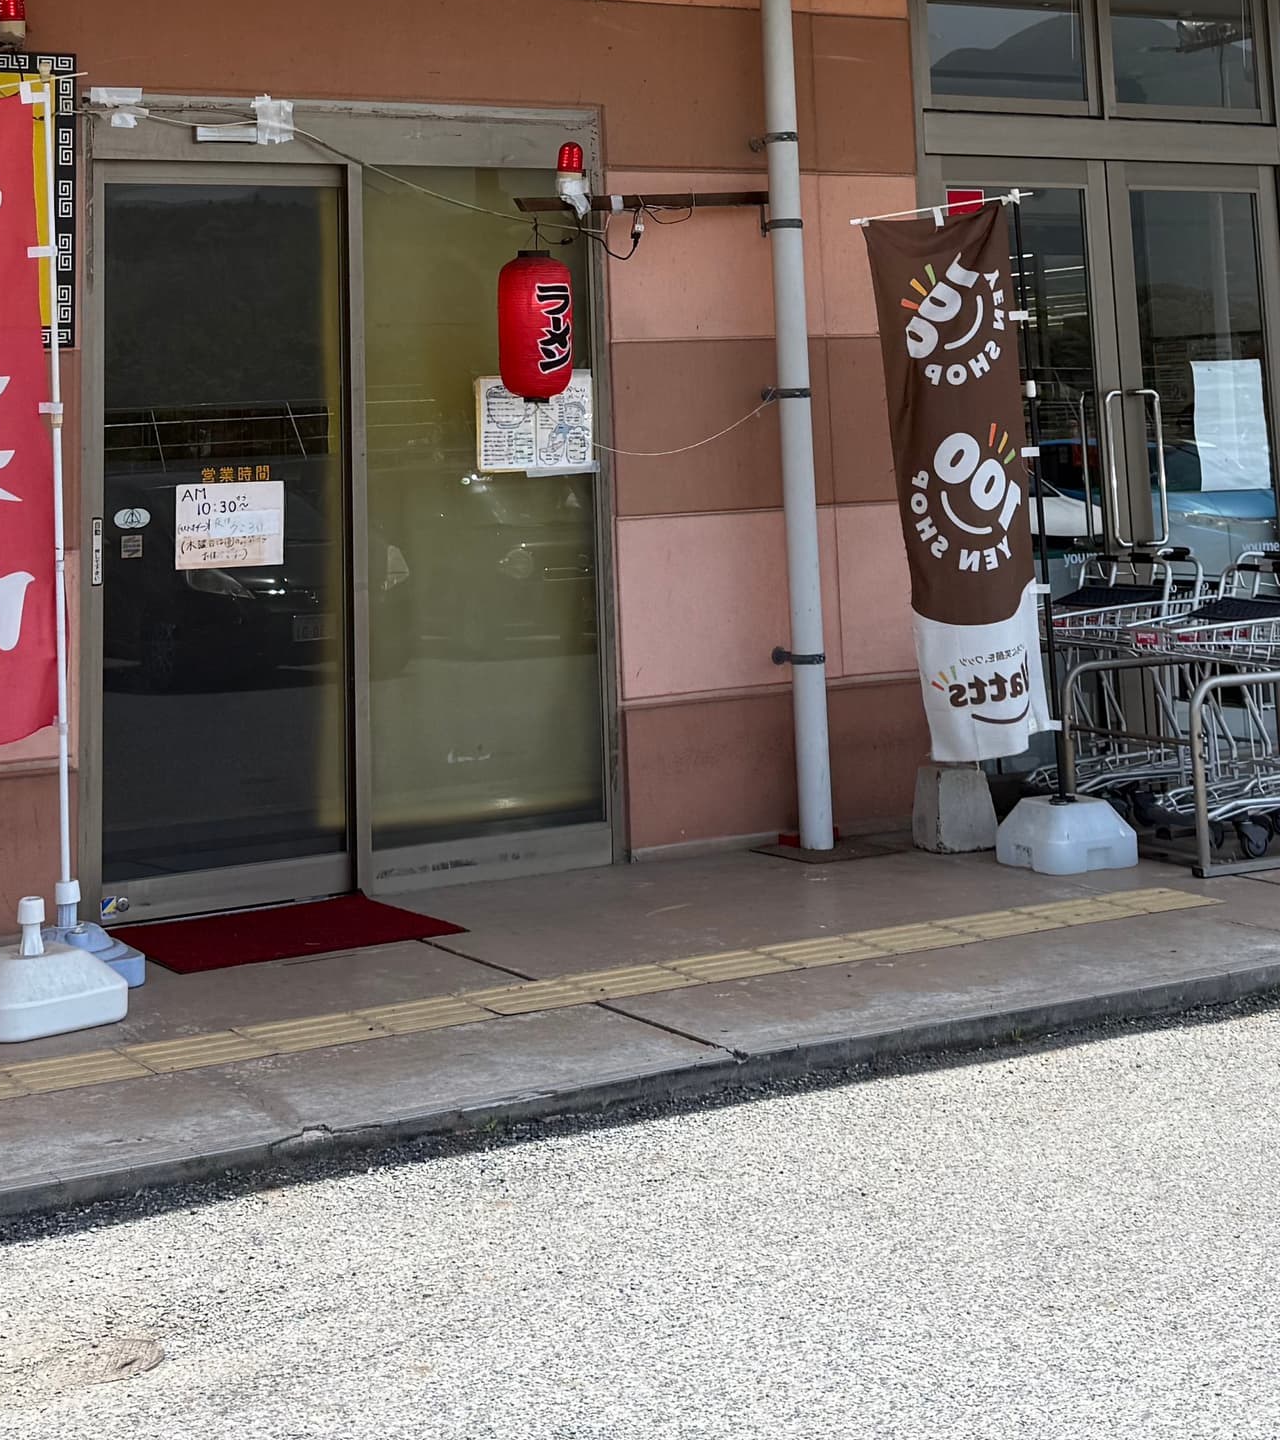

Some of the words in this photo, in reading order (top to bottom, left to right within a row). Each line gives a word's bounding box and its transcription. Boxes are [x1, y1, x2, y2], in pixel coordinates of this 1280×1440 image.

[535, 282, 574, 375] ラーメン
[201, 465, 270, 483] 営業時間
[181, 487, 207, 502] AM
[1063, 552, 1105, 568] you
